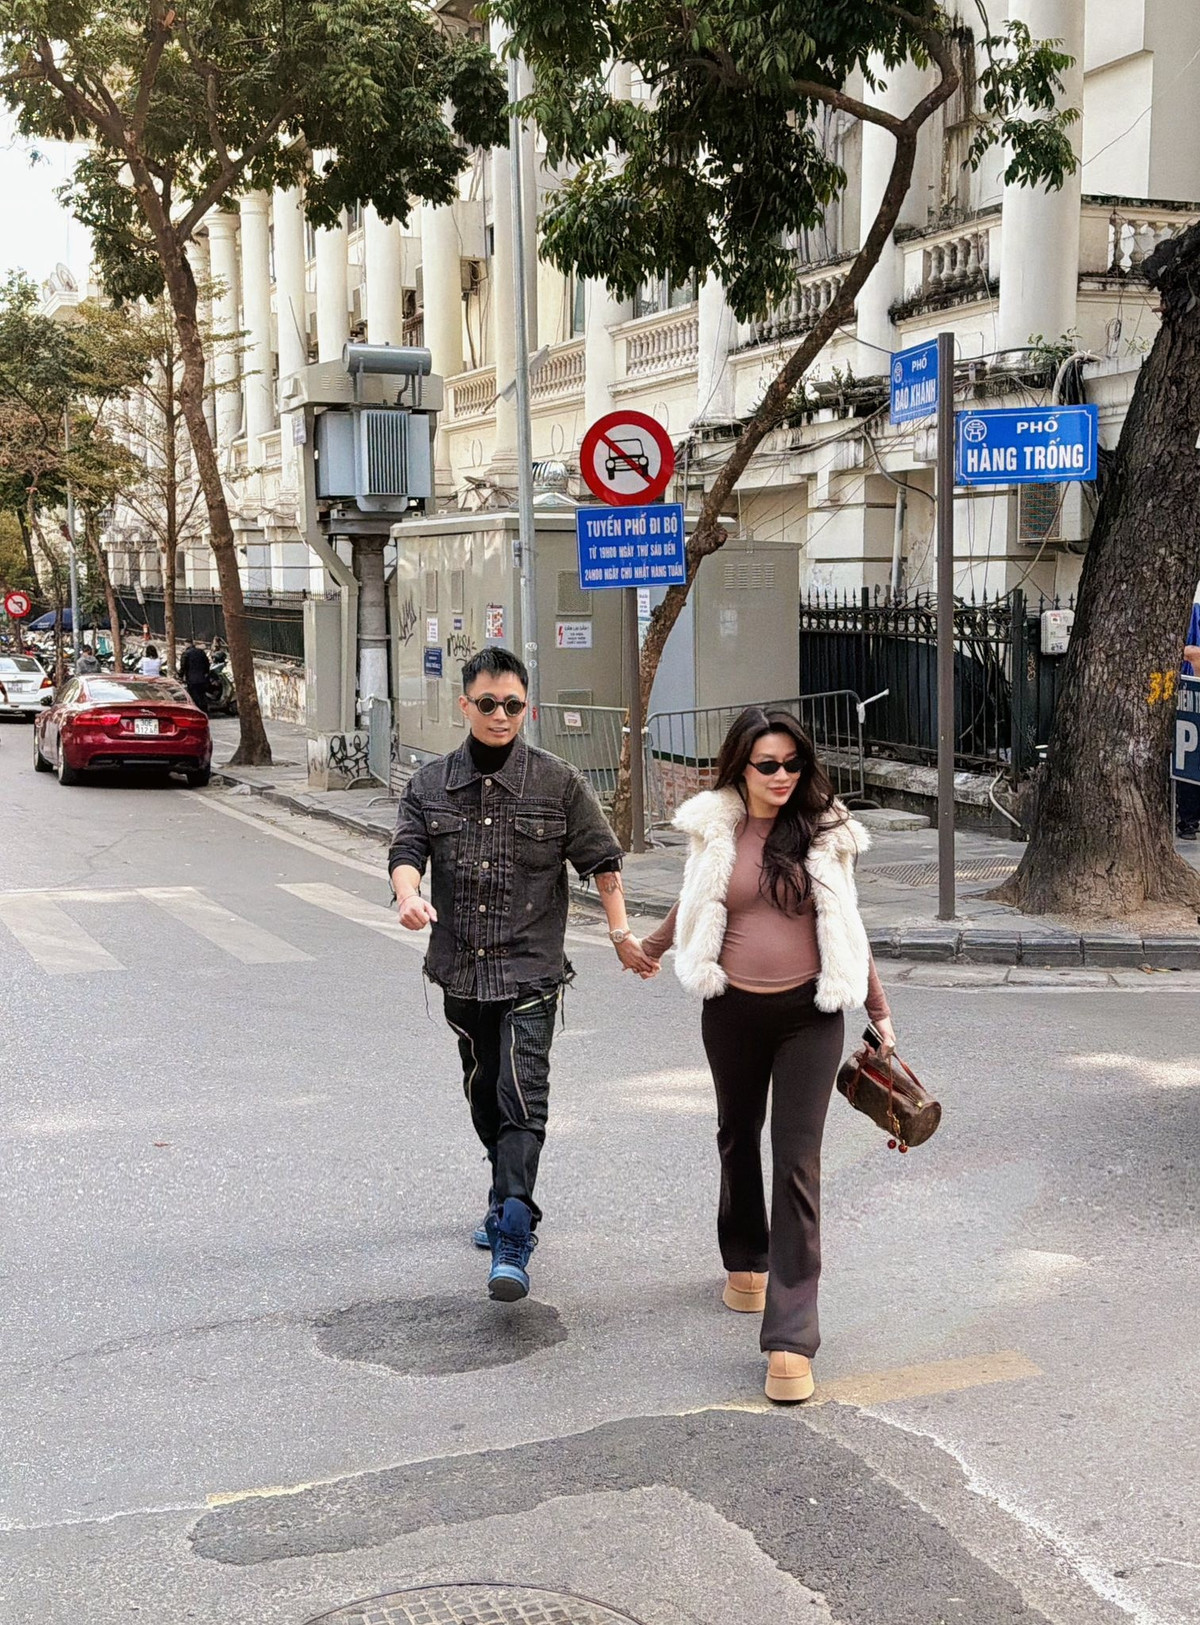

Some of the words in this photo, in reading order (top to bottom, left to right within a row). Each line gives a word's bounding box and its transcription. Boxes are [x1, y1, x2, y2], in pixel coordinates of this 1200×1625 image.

[911, 351, 928, 373] PHỐ
[910, 376, 936, 408] KHÁNH
[1016, 414, 1060, 434] PHỐ
[967, 442, 1017, 473] HÀNG
[1023, 437, 1084, 471] TRỐNG
[586, 514, 622, 538] TUYẾN
[624, 512, 647, 536] PHỐ
[649, 517, 661, 535] ĐI
[663, 512, 678, 537] BỘ
[618, 542, 634, 558] NGÀY
[650, 541, 662, 557] SÁU
[1175, 719, 1198, 770] P
